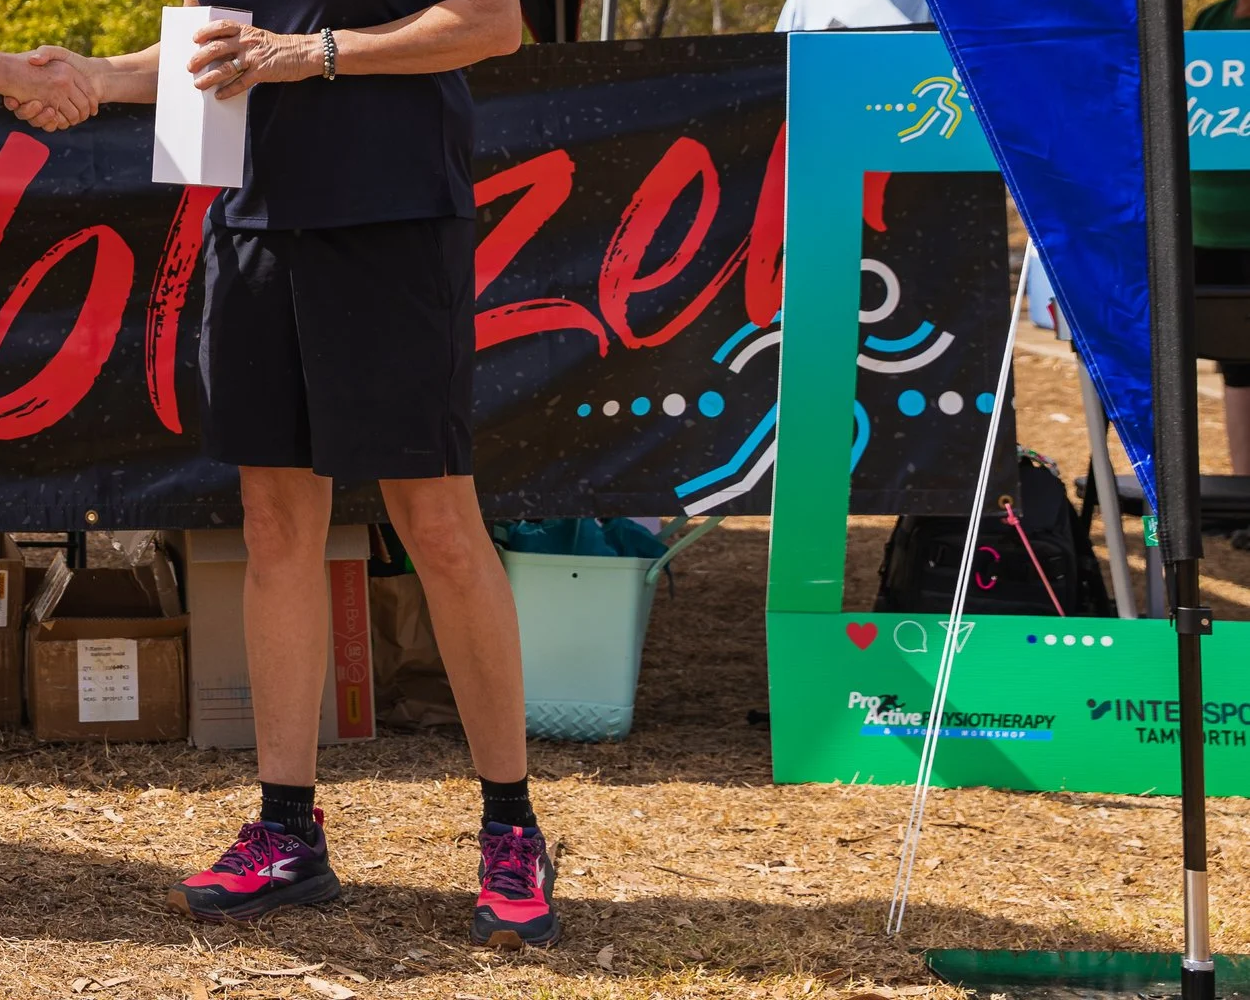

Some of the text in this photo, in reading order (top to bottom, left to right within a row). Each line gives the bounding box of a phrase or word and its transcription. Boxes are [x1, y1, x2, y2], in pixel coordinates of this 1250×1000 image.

[848, 691, 881, 709] Pro
[863, 707, 922, 726] Active
[1115, 699, 1250, 725] INTESPO
[906, 728, 950, 736] SPOS
[1135, 727, 1247, 747] TAMRTH
